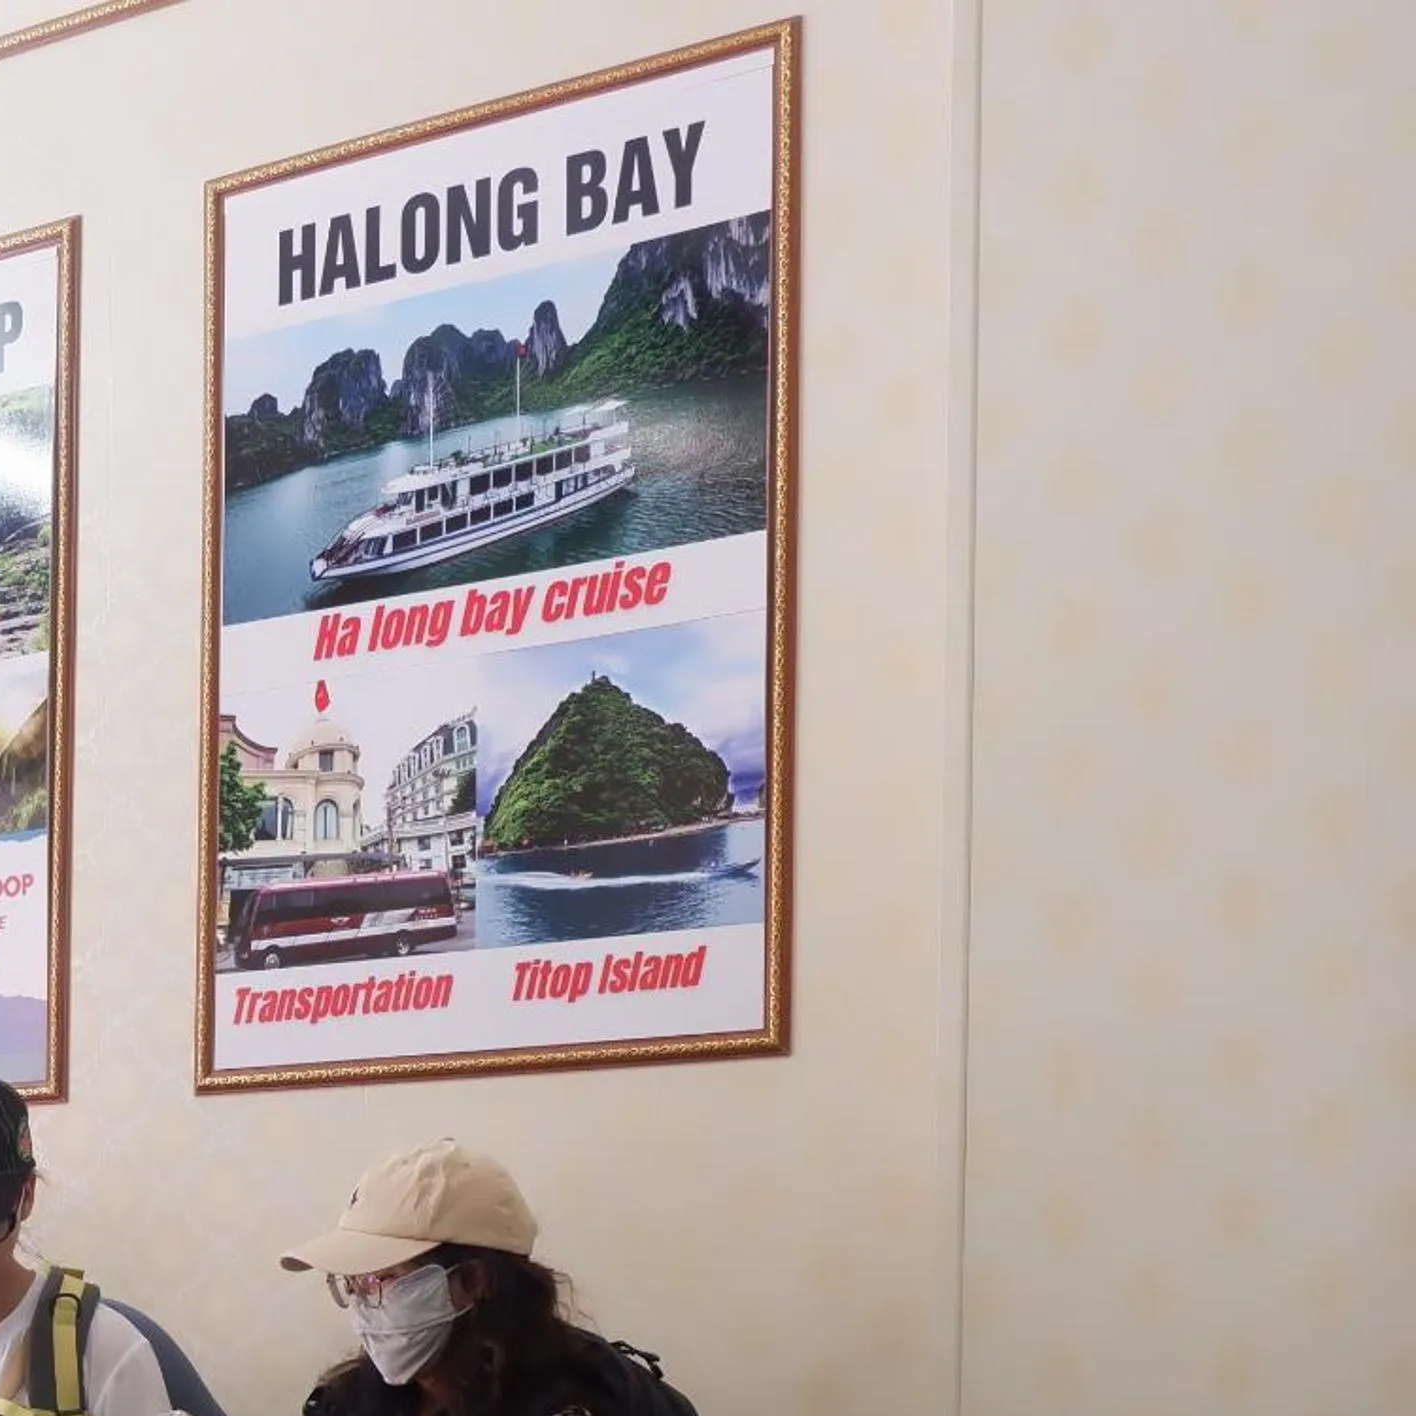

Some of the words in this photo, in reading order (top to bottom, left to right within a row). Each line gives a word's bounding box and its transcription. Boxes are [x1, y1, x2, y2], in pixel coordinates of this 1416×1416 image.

[278, 167, 539, 306] HALONG
[564, 121, 706, 237] BAY
[313, 612, 361, 662] Ha
[368, 597, 455, 653] long
[460, 586, 536, 639] bay
[541, 560, 672, 622] cruise
[233, 971, 453, 1027] Transportation
[513, 951, 593, 1004] Titop
[598, 944, 707, 995] Island
